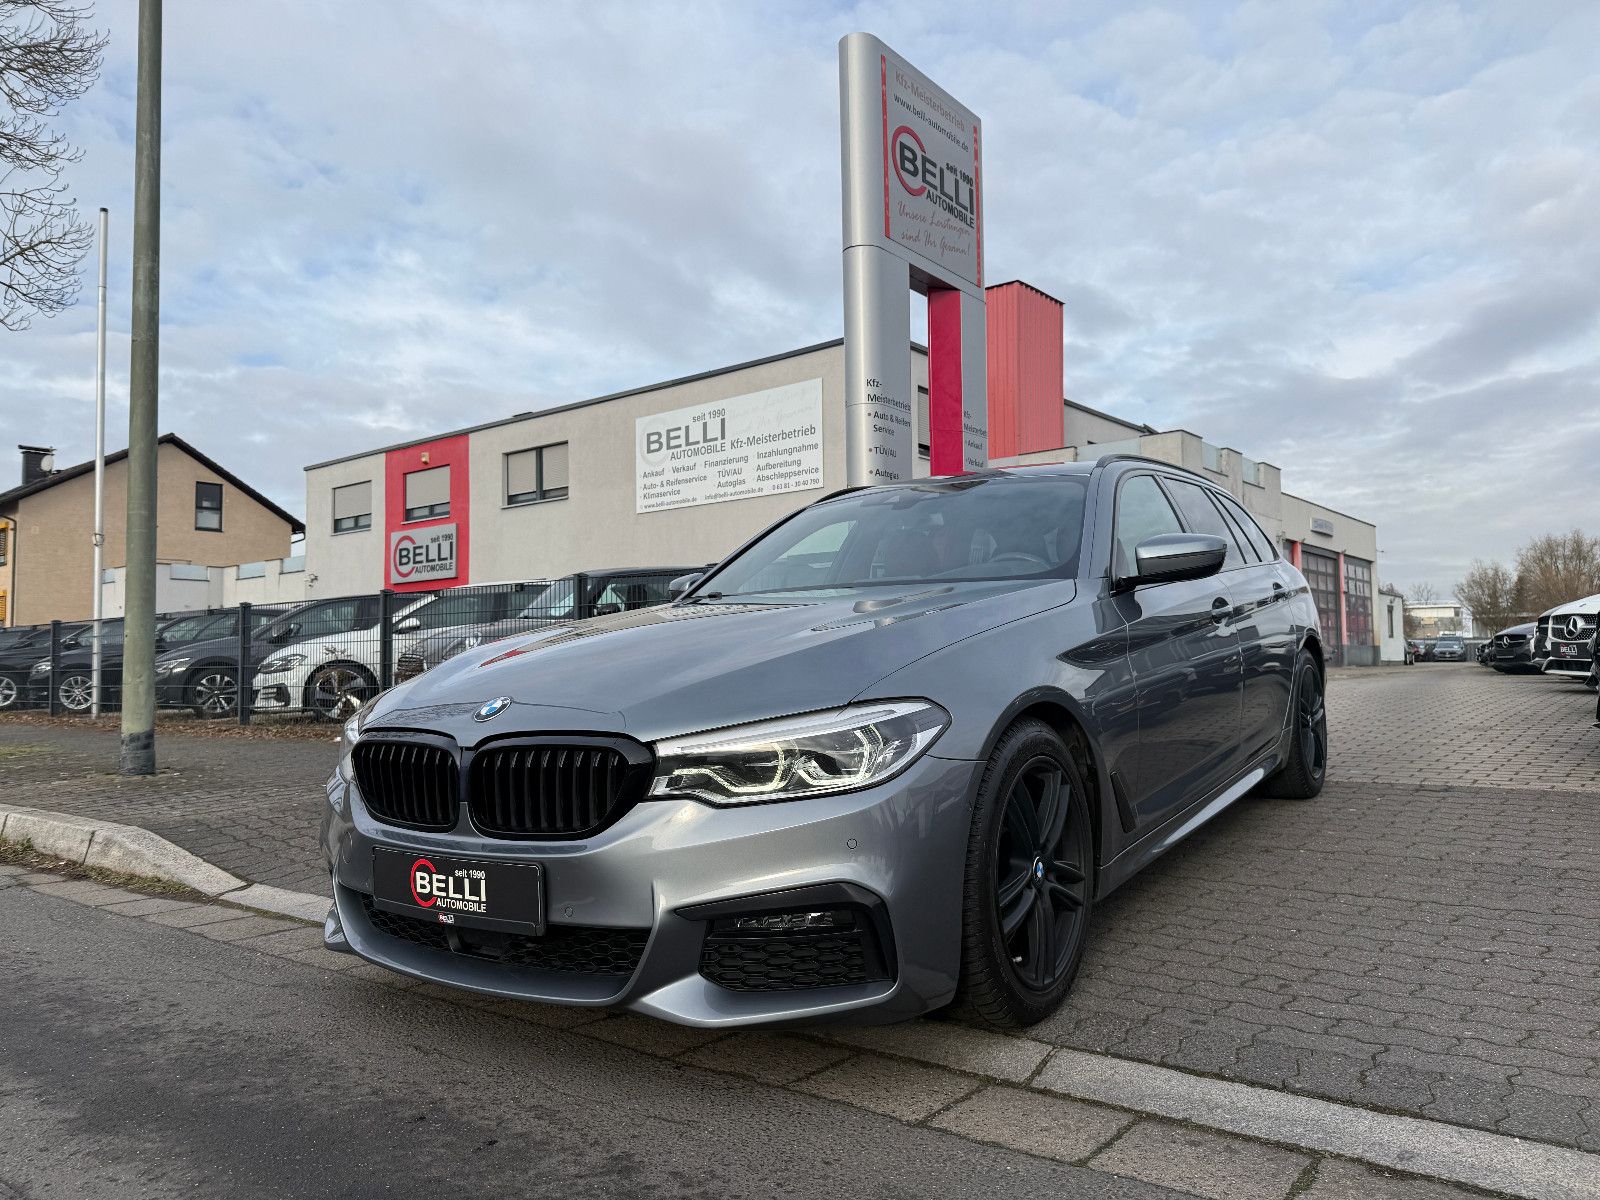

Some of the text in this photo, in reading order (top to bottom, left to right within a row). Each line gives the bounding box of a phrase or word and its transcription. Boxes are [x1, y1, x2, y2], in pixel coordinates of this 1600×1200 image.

[895, 70, 965, 132] Kfz-Meisterbetrieb
[899, 140, 975, 216] BELLI
[945, 161, 974, 188] seit 1990
[926, 189, 975, 230] AUTOMOBILE
[866, 378, 882, 388] Kfz-
[867, 393, 911, 411] Meisterbetrieb
[692, 408, 726, 423] seit 1990
[873, 410, 889, 421] Auto
[646, 418, 725, 454] BELLI
[730, 424, 816, 450] Kfz-Meisterbetrieb
[873, 424, 895, 436] Service
[642, 442, 819, 479] Ankauf Verkauf Finanzierung Inzahlungnahme
[669, 442, 726, 461] AUTOMOBILE
[643, 466, 820, 500] Klimaservice Autoglas Abschleppservice
[665, 474, 707, 487] Reifenservice
[756, 458, 802, 472] Aufbereitung
[431, 533, 453, 543] seit 1990
[399, 542, 453, 566] BELLI
[415, 562, 453, 574] AUTOMOBILE
[455, 869, 485, 879] seit 1990
[415, 872, 486, 902] BELLI
[436, 897, 487, 913] AUTOMOBILE
